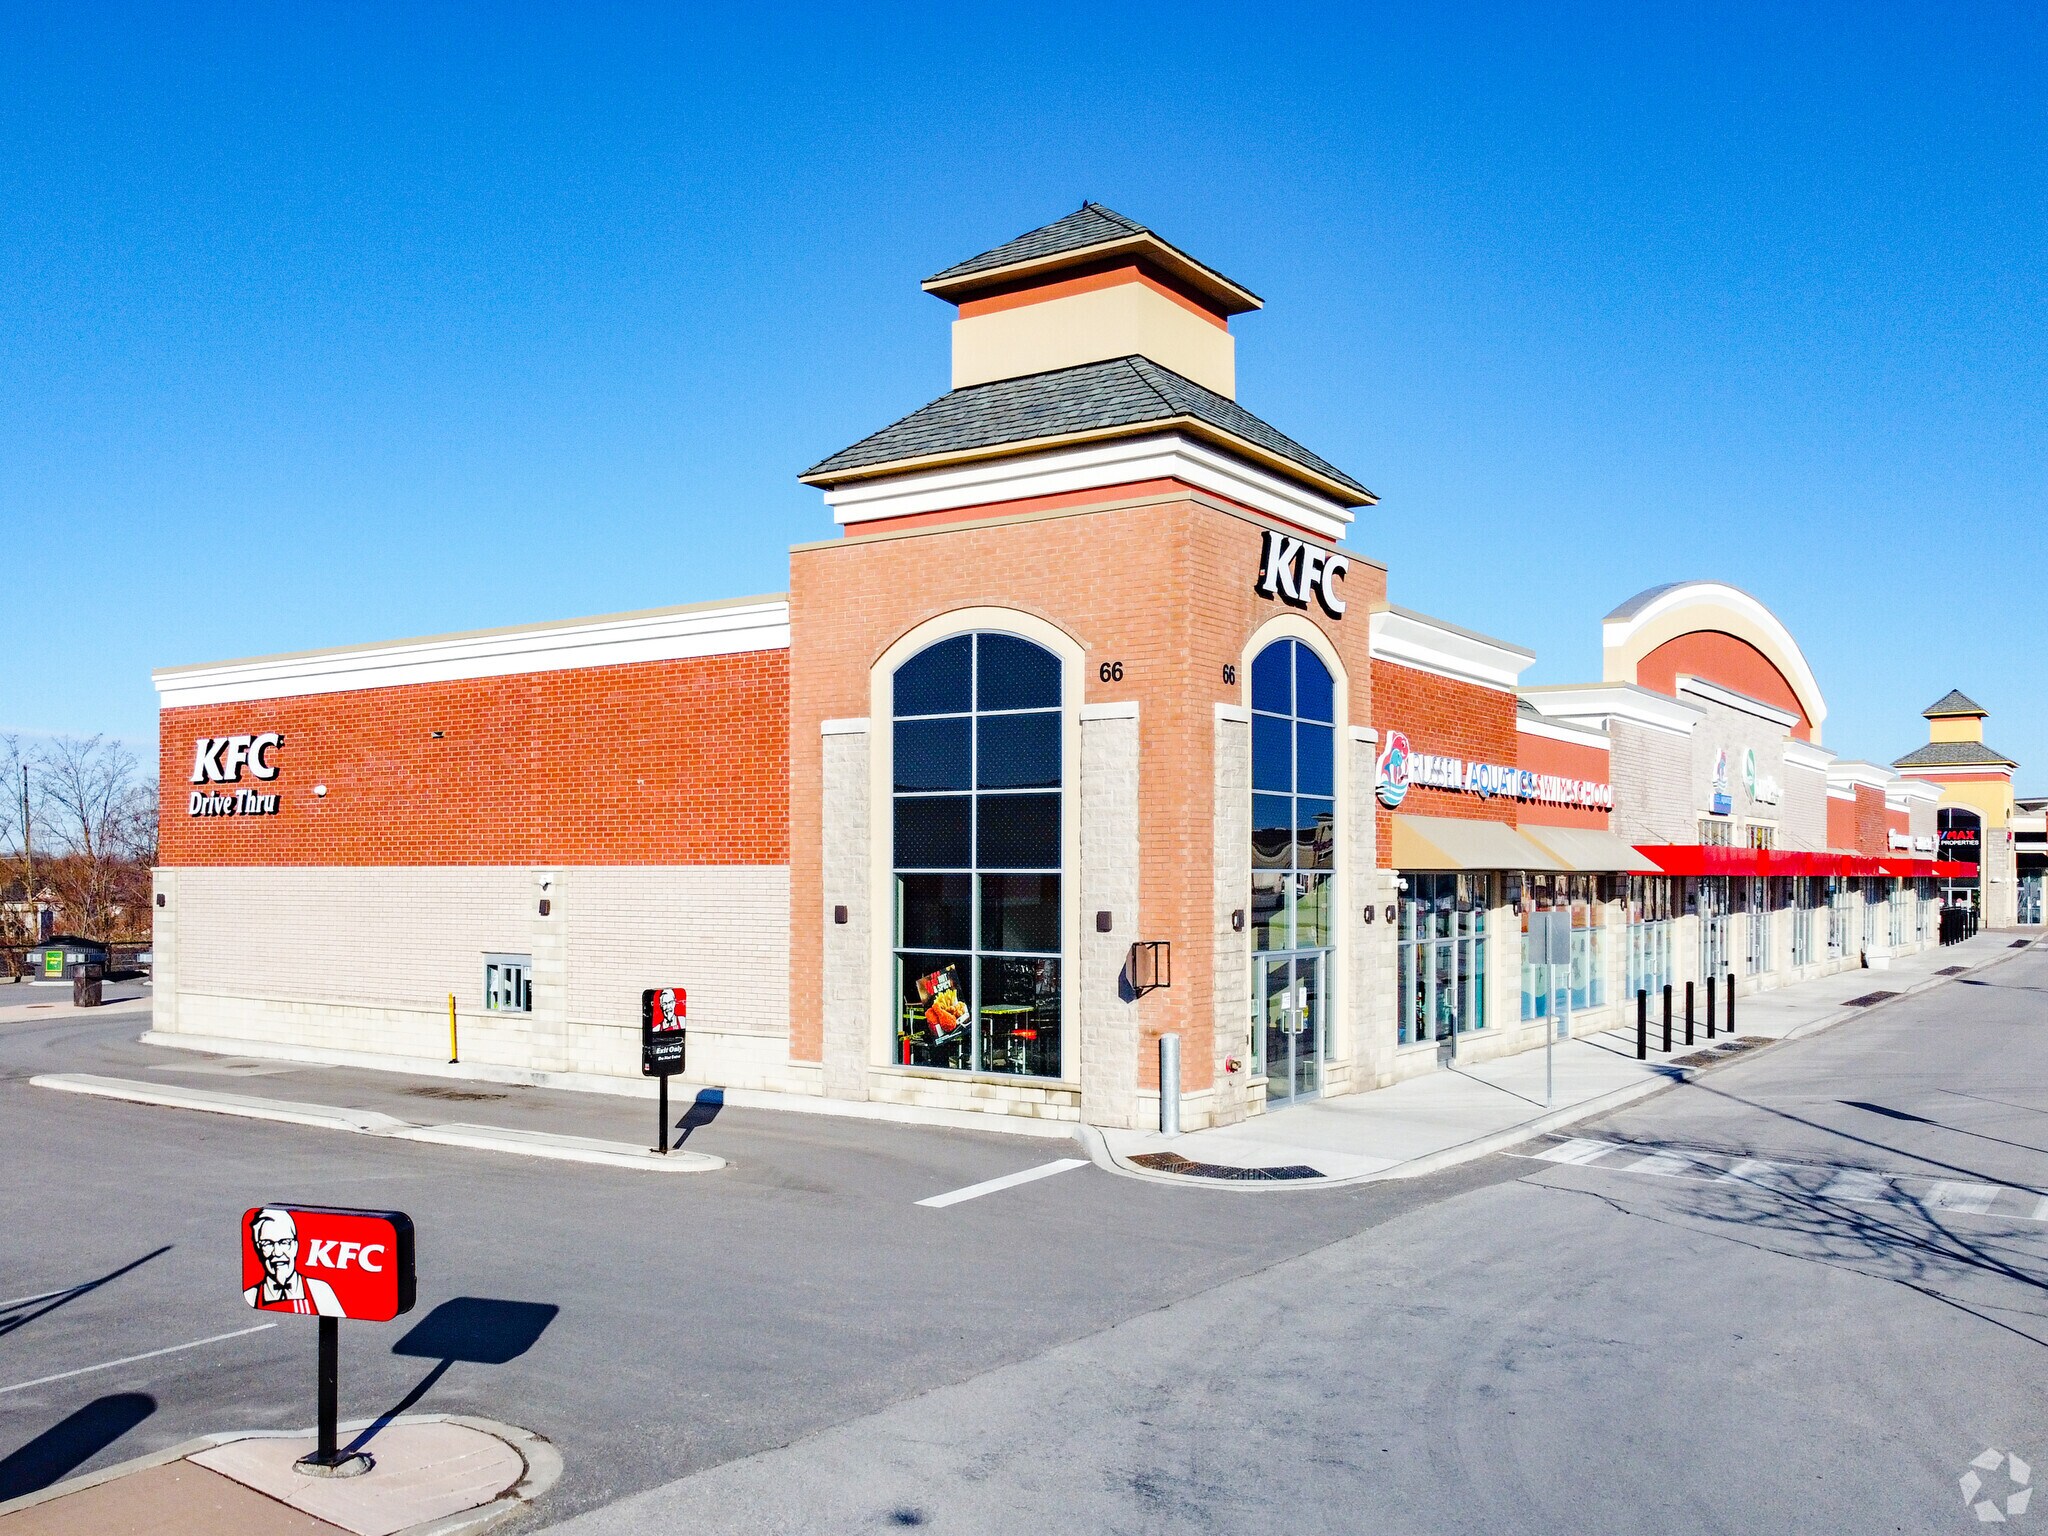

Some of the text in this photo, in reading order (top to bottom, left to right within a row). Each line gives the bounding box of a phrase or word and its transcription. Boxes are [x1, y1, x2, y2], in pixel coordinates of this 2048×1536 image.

[1258, 531, 1349, 618] KFC
[1100, 662, 1124, 682] 66
[1222, 664, 1236, 685] 66
[190, 732, 281, 784] KFC
[1467, 762, 1534, 798] AQUATICS
[1534, 773, 1570, 802] SWIM
[1567, 779, 1617, 809] SCHOOL
[189, 789, 279, 816] Drive Thru
[669, 1045, 682, 1053] Only
[305, 1239, 385, 1273] KFC
